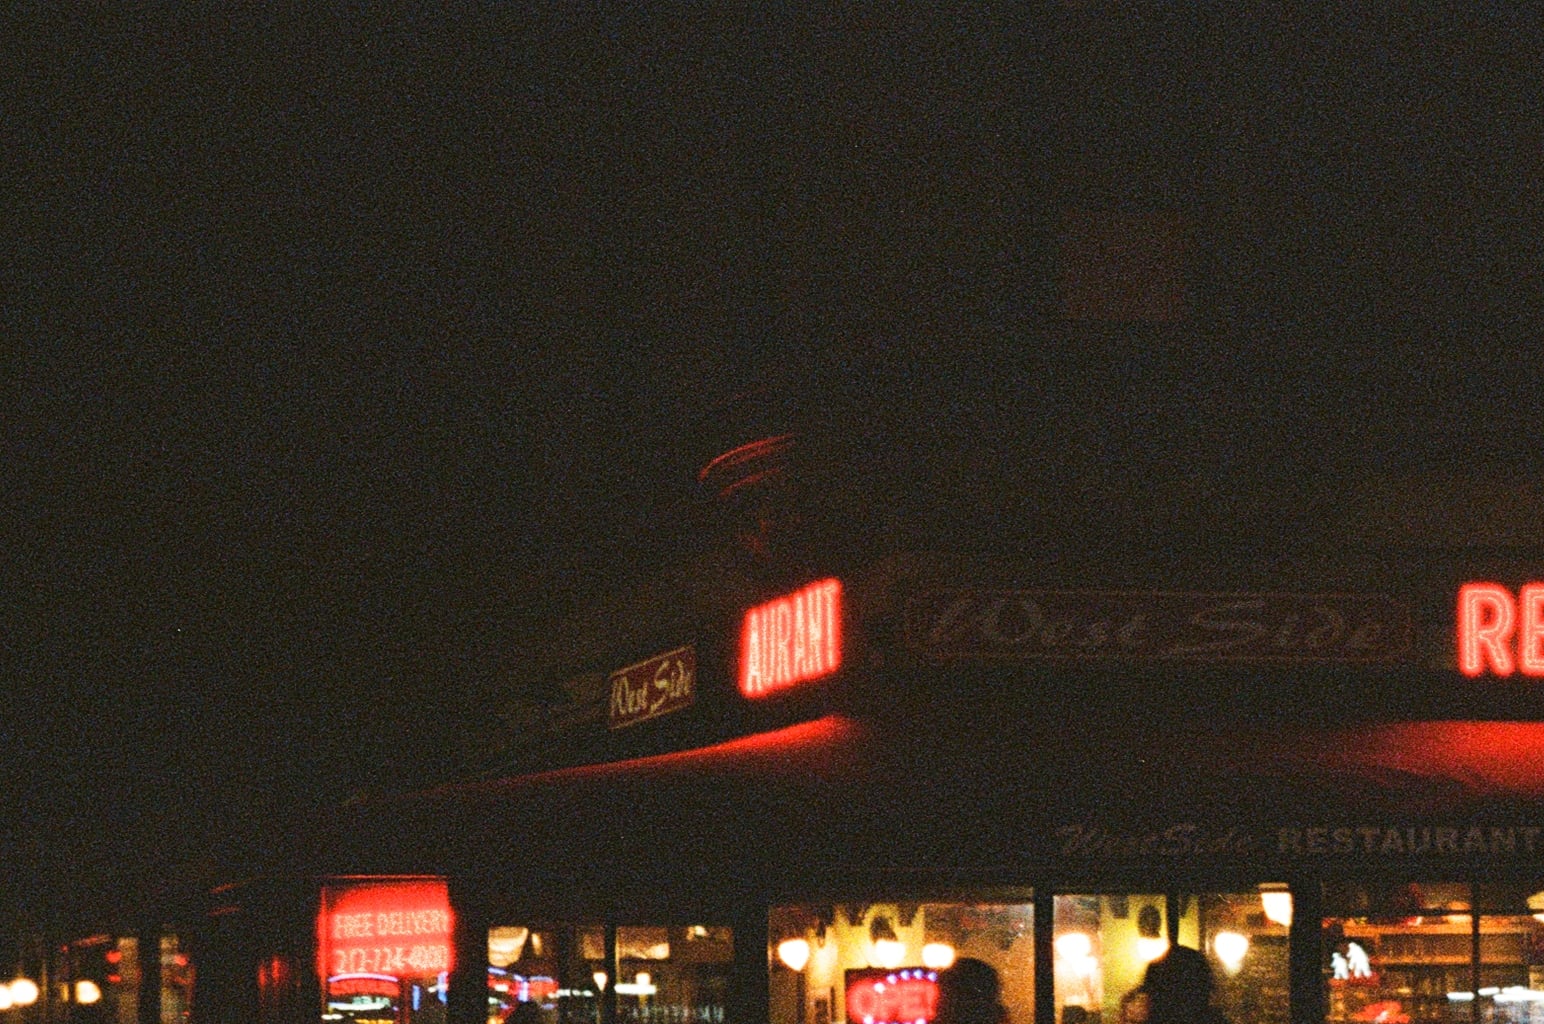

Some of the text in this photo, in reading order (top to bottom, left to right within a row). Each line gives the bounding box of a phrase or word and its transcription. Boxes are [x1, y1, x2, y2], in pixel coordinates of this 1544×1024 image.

[743, 582, 839, 695] AURANT
[1278, 826, 1541, 854] RESTAURANT
[334, 913, 374, 939] FREE
